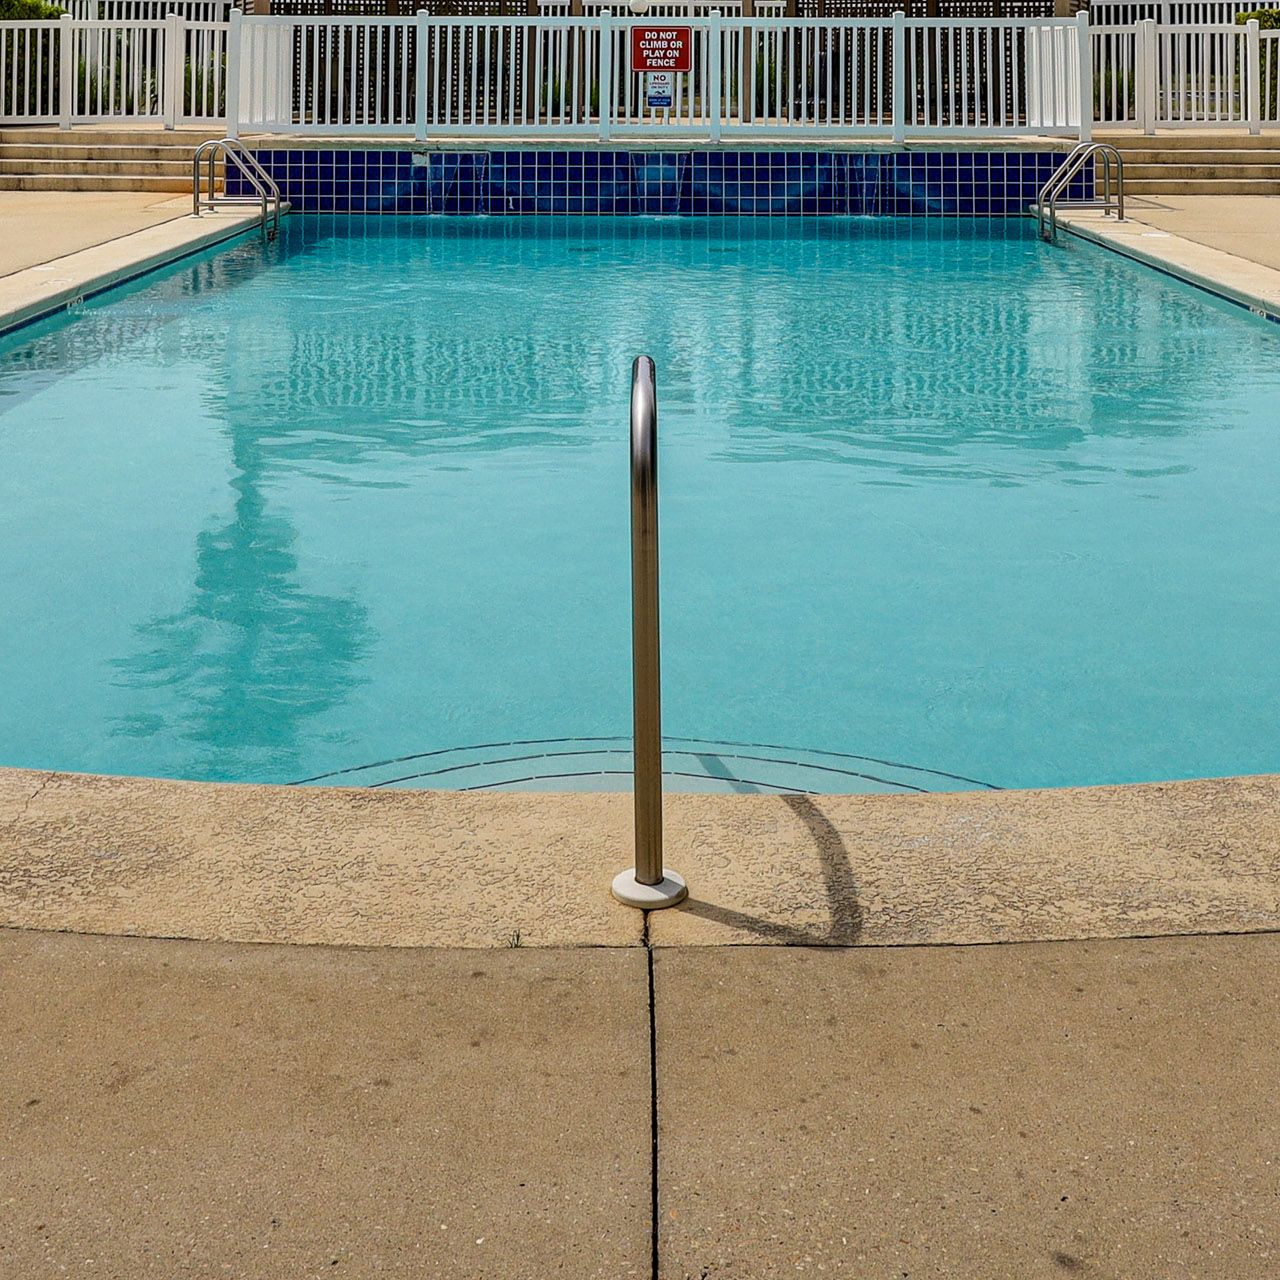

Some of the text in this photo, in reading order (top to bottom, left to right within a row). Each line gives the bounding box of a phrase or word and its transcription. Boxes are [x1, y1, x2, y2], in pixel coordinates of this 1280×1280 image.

[645, 31, 677, 39] DO NOT
[646, 59, 676, 67] FENCE
